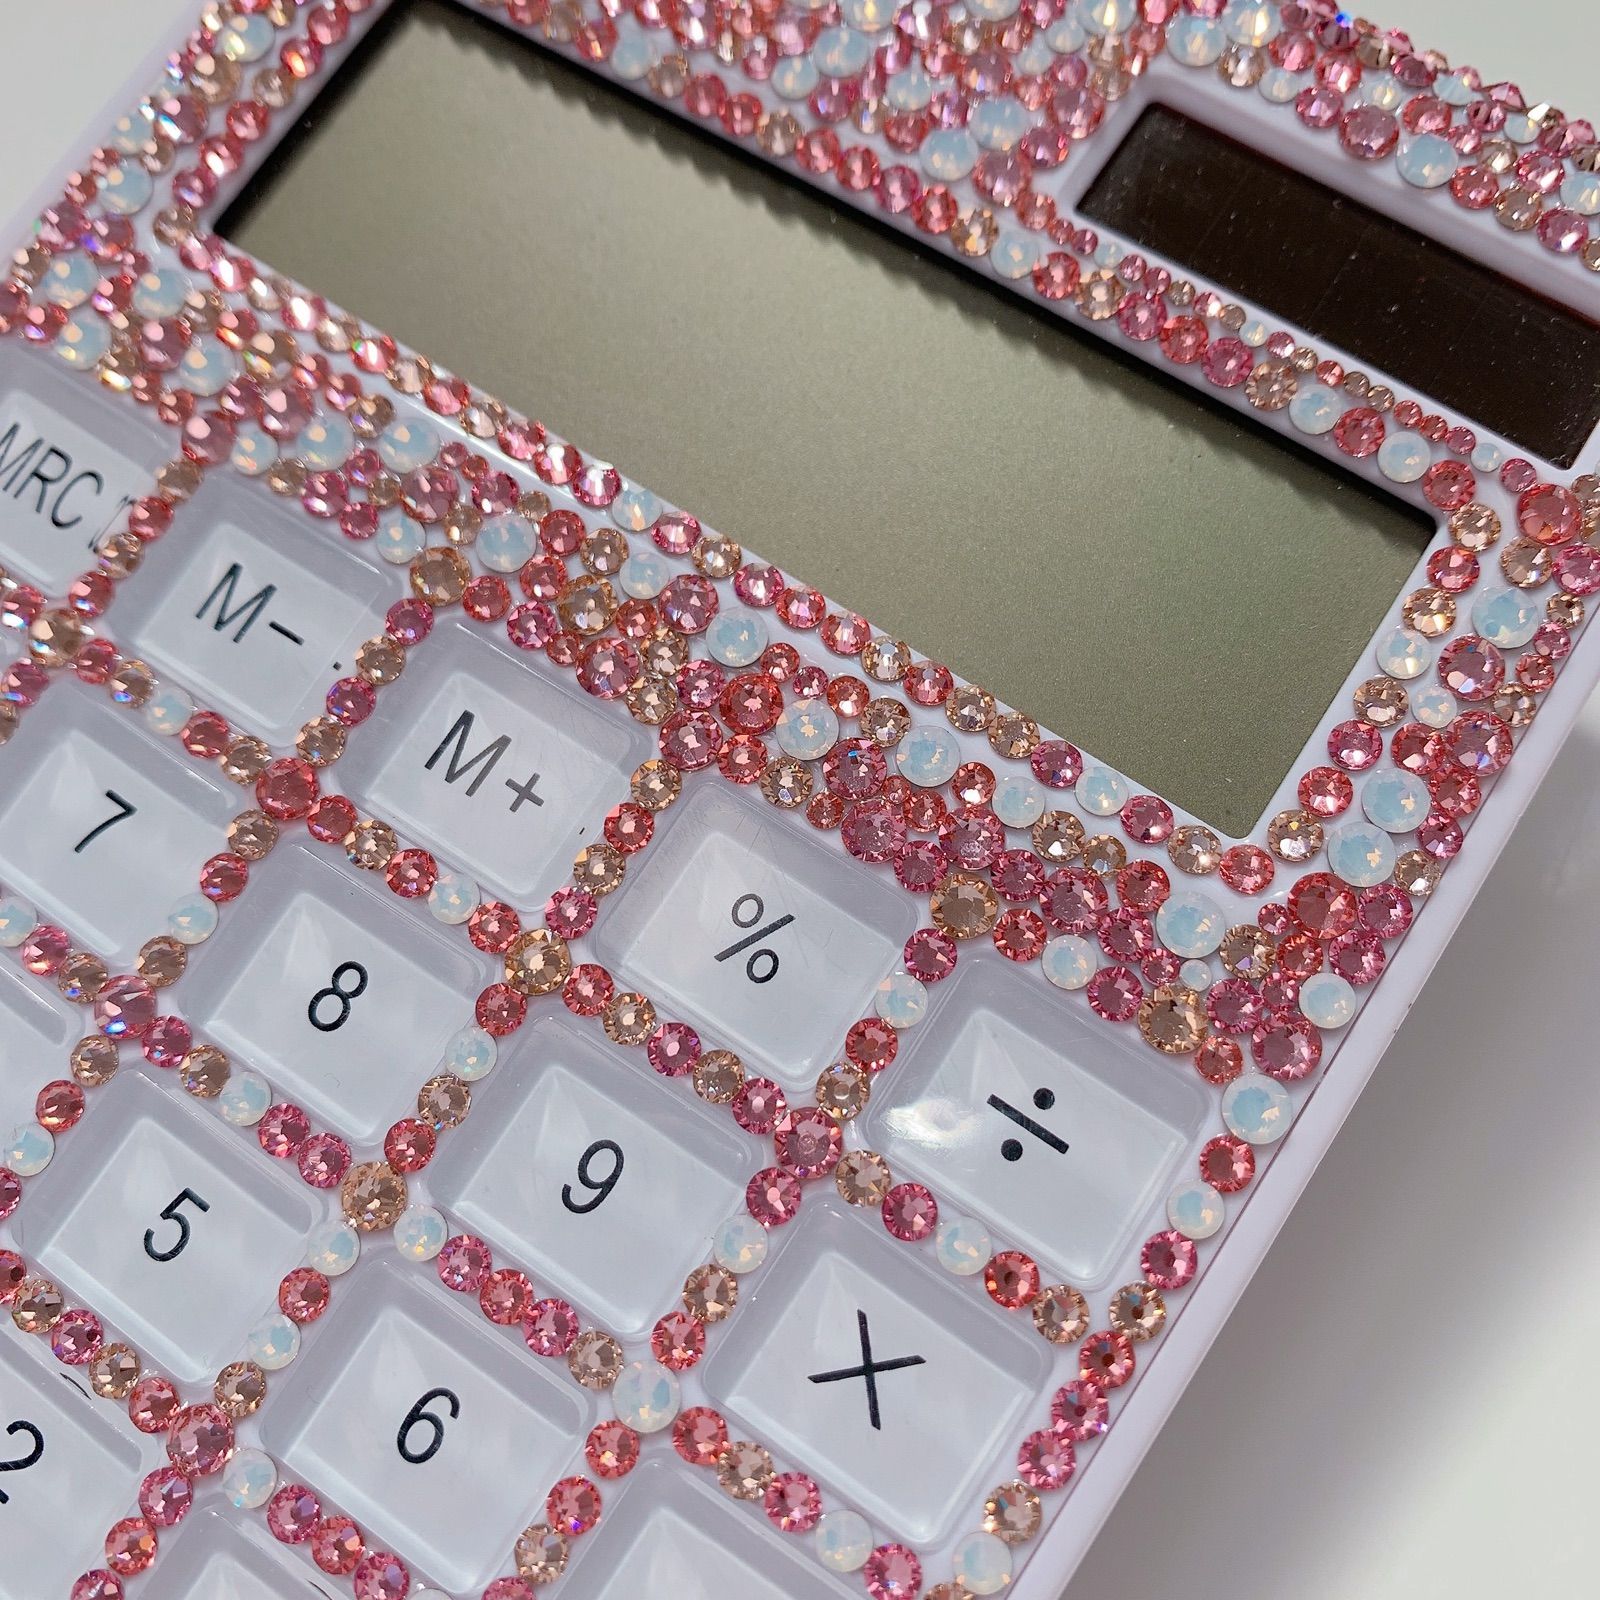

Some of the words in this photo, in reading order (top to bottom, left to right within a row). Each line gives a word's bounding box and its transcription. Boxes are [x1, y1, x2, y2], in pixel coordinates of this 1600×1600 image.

[424, 710, 544, 812] M+
[74, 790, 137, 853] 7
[714, 894, 796, 983] %
[308, 961, 368, 1032] 8
[987, 1088, 1069, 1162] ÷
[562, 1140, 624, 1214] 9
[144, 1188, 210, 1262] 5
[397, 1388, 460, 1464] 6
